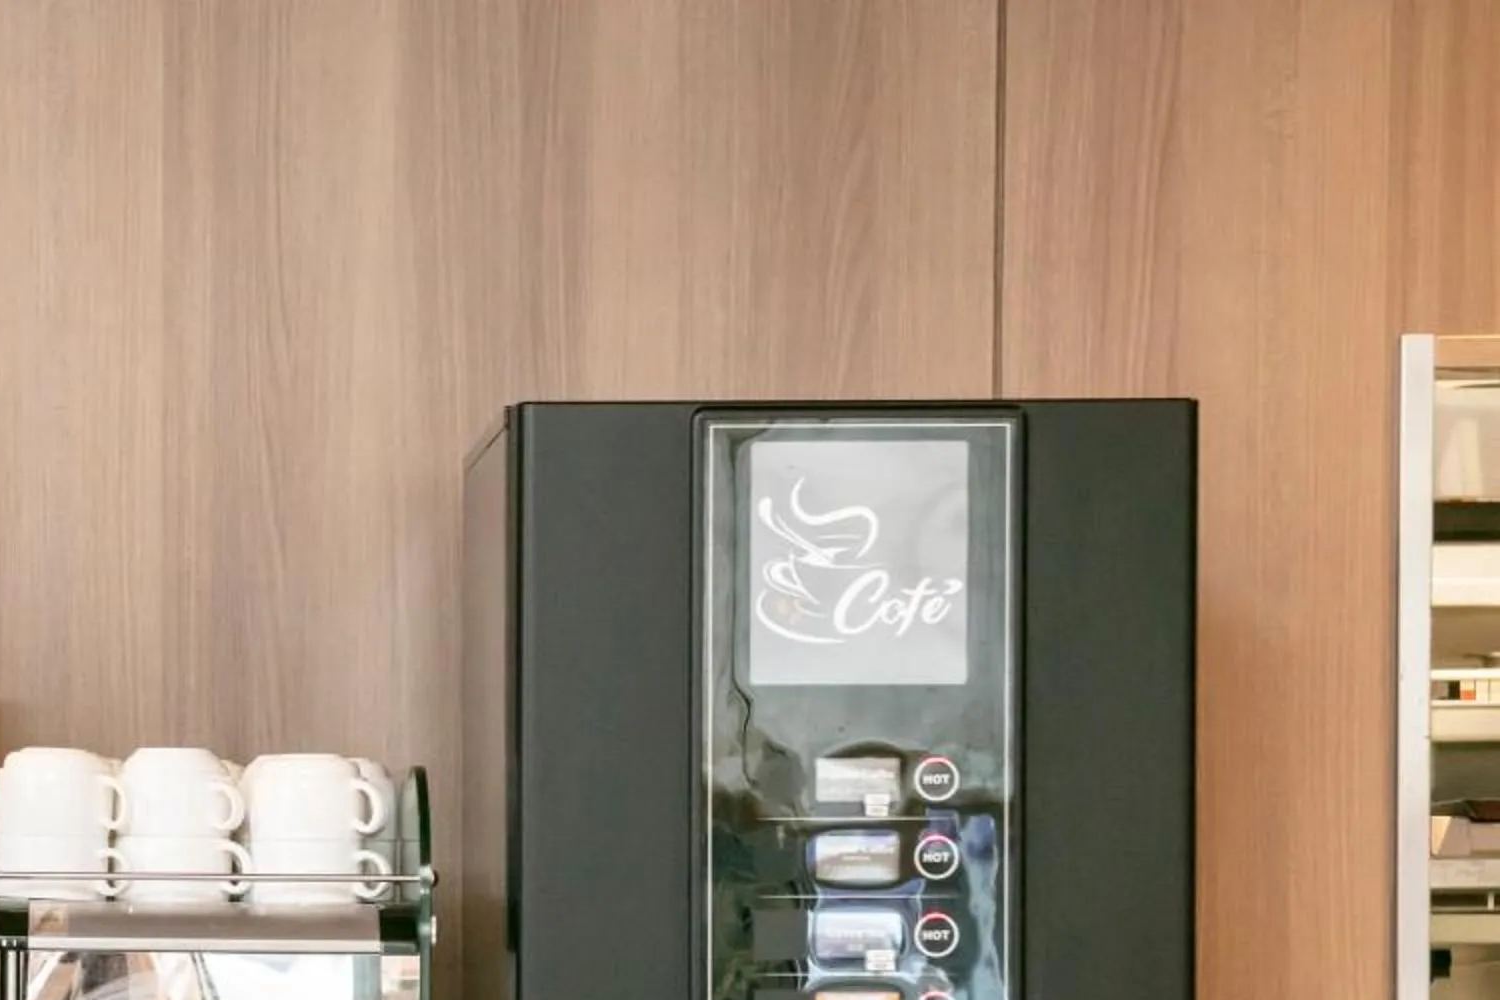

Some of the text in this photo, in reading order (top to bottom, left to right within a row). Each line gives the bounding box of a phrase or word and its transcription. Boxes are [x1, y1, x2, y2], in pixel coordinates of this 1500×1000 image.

[833, 570, 963, 638] Café
[922, 773, 951, 784] HOT
[922, 852, 951, 863] HOT
[922, 930, 951, 941] HOT
